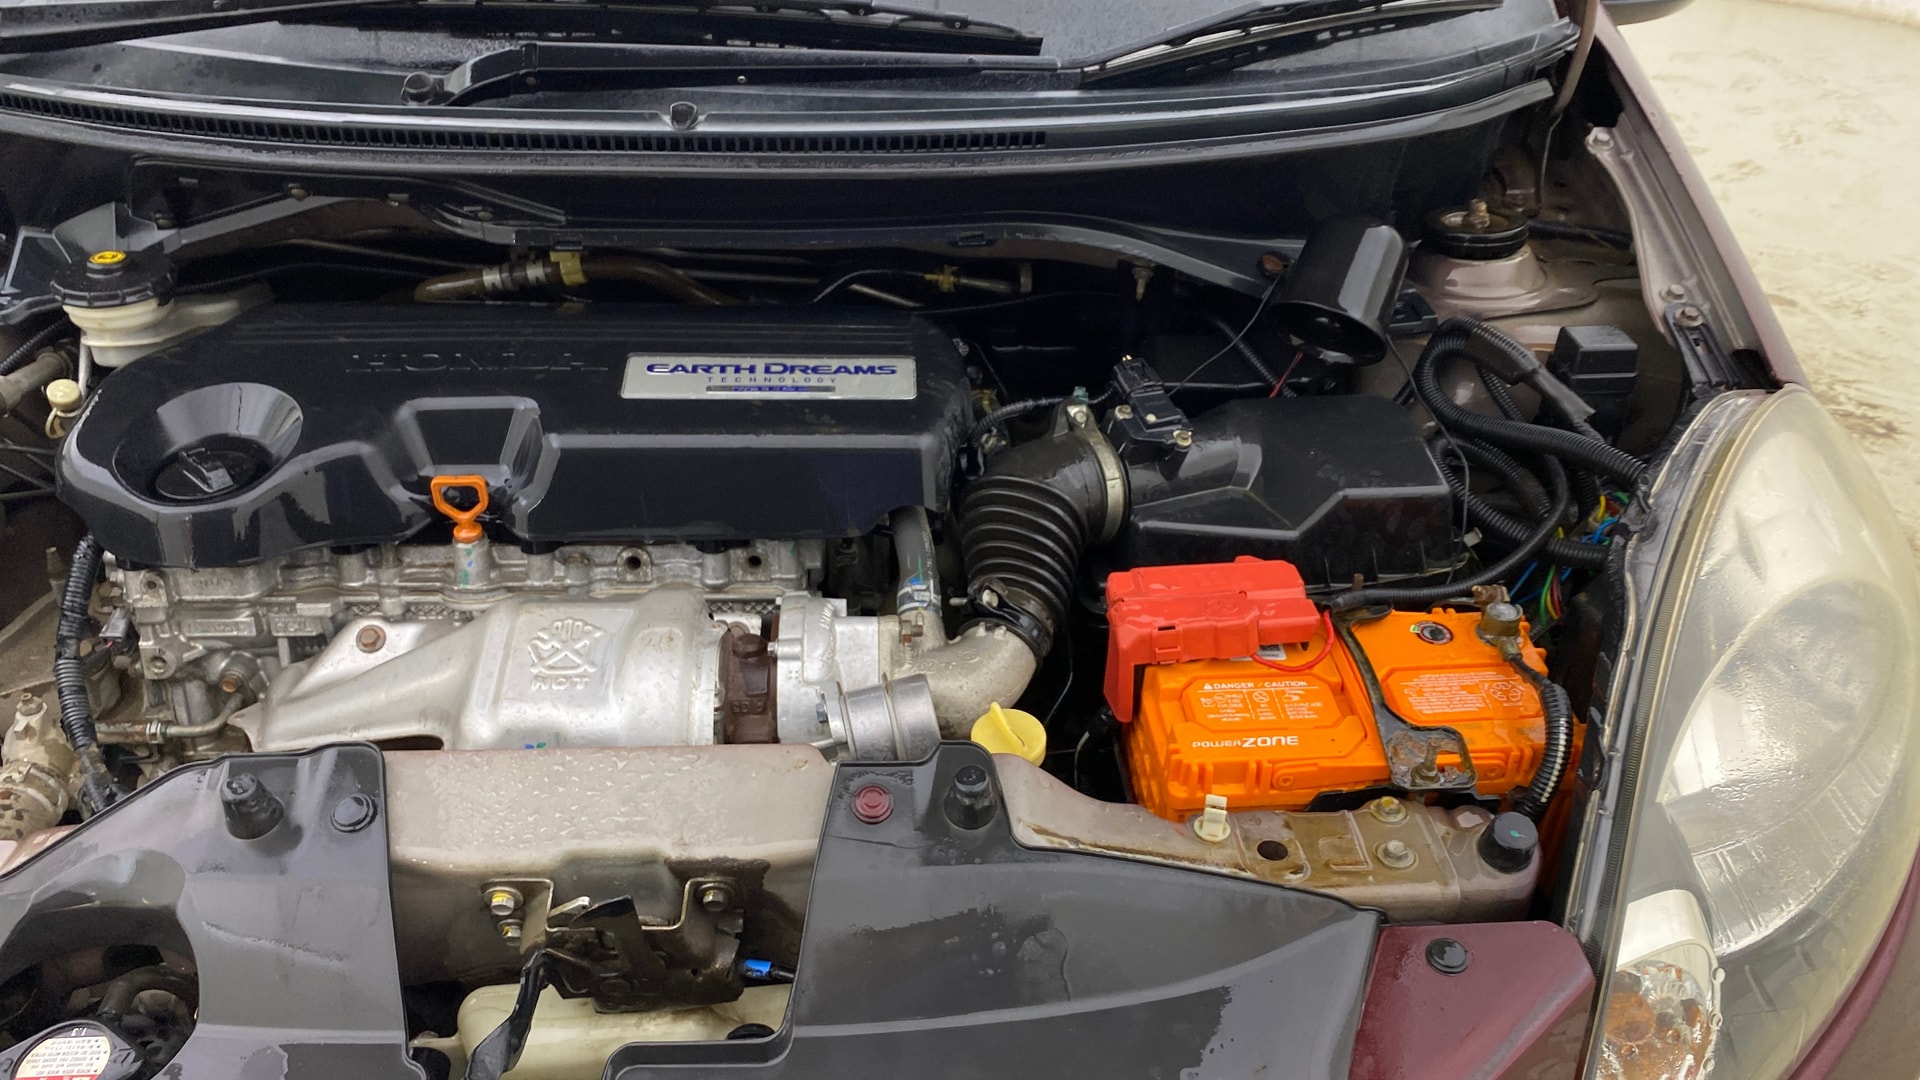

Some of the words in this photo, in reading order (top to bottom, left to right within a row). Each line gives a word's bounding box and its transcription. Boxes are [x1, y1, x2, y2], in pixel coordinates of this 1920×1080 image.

[646, 363, 757, 375] EARTH
[764, 362, 897, 375] DREAMS
[1213, 681, 1254, 690] DANGER
[1264, 680, 1309, 688] CAUTION
